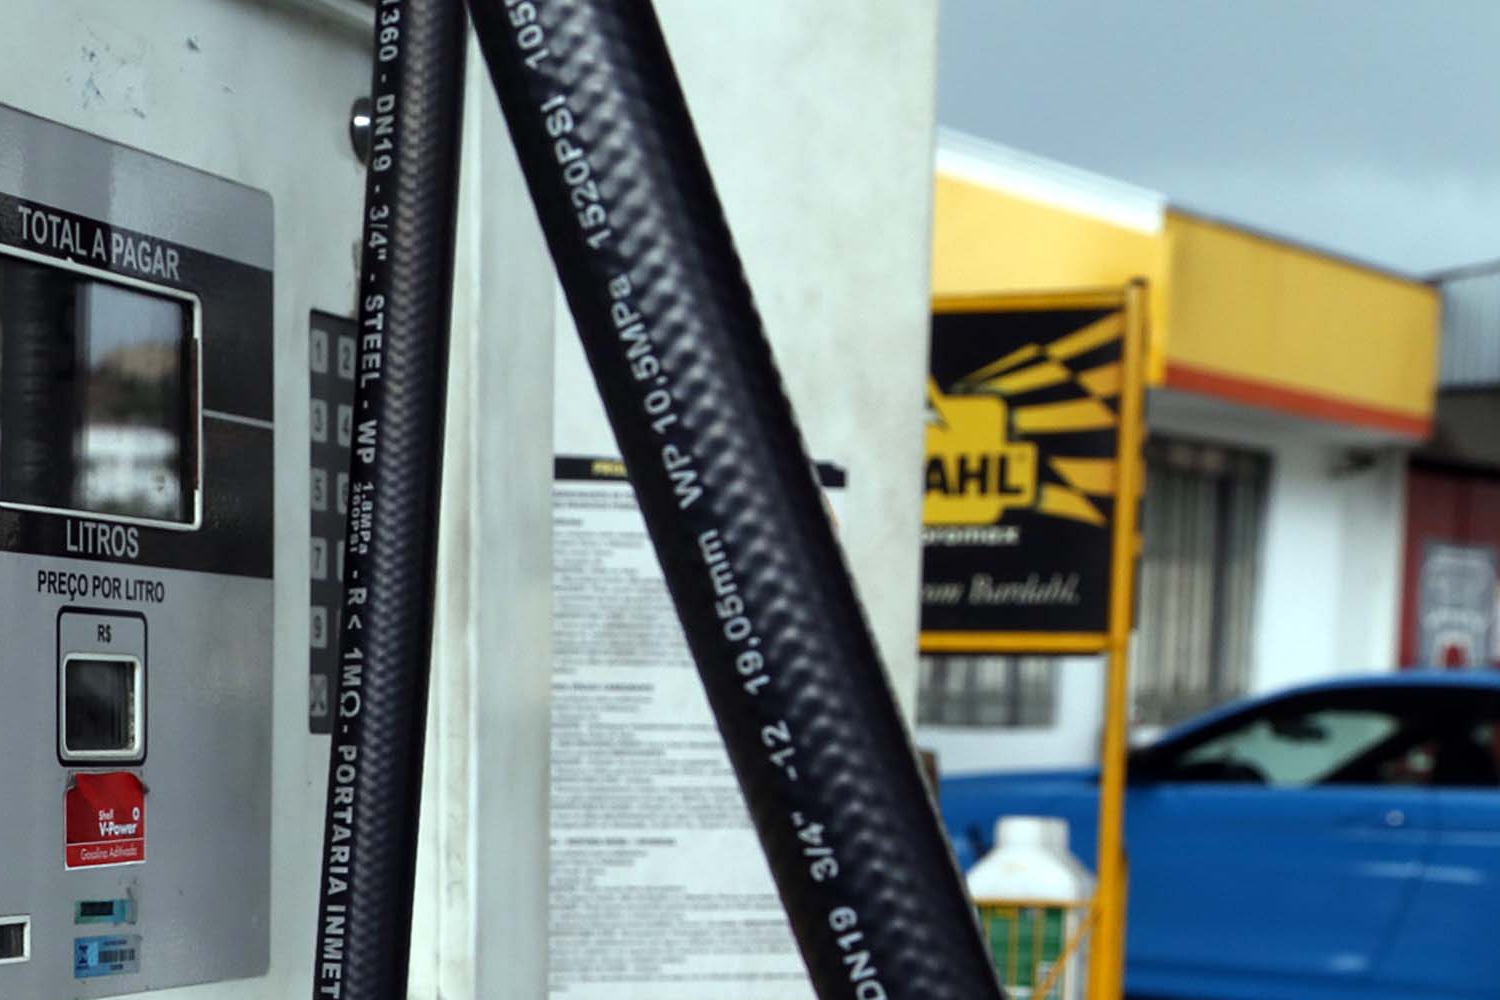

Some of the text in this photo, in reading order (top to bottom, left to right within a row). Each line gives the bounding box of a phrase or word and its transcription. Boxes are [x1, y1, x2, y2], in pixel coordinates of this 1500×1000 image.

[506, 0, 550, 70] 105
[373, 93, 395, 172] DN19
[540, 94, 612, 251] 1520PSI
[18, 204, 180, 281] TOTAL A PAGAR
[360, 294, 385, 389] STEEL
[356, 419, 378, 464] WP
[661, 443, 704, 510] WP
[66, 521, 139, 559] LITROS
[38, 570, 165, 603] PREÇO POR LITRO
[348, 587, 367, 606] R
[698, 528, 770, 696] 19.05mm
[97, 624, 112, 644] R$
[327, 744, 357, 895] PORTARIA
